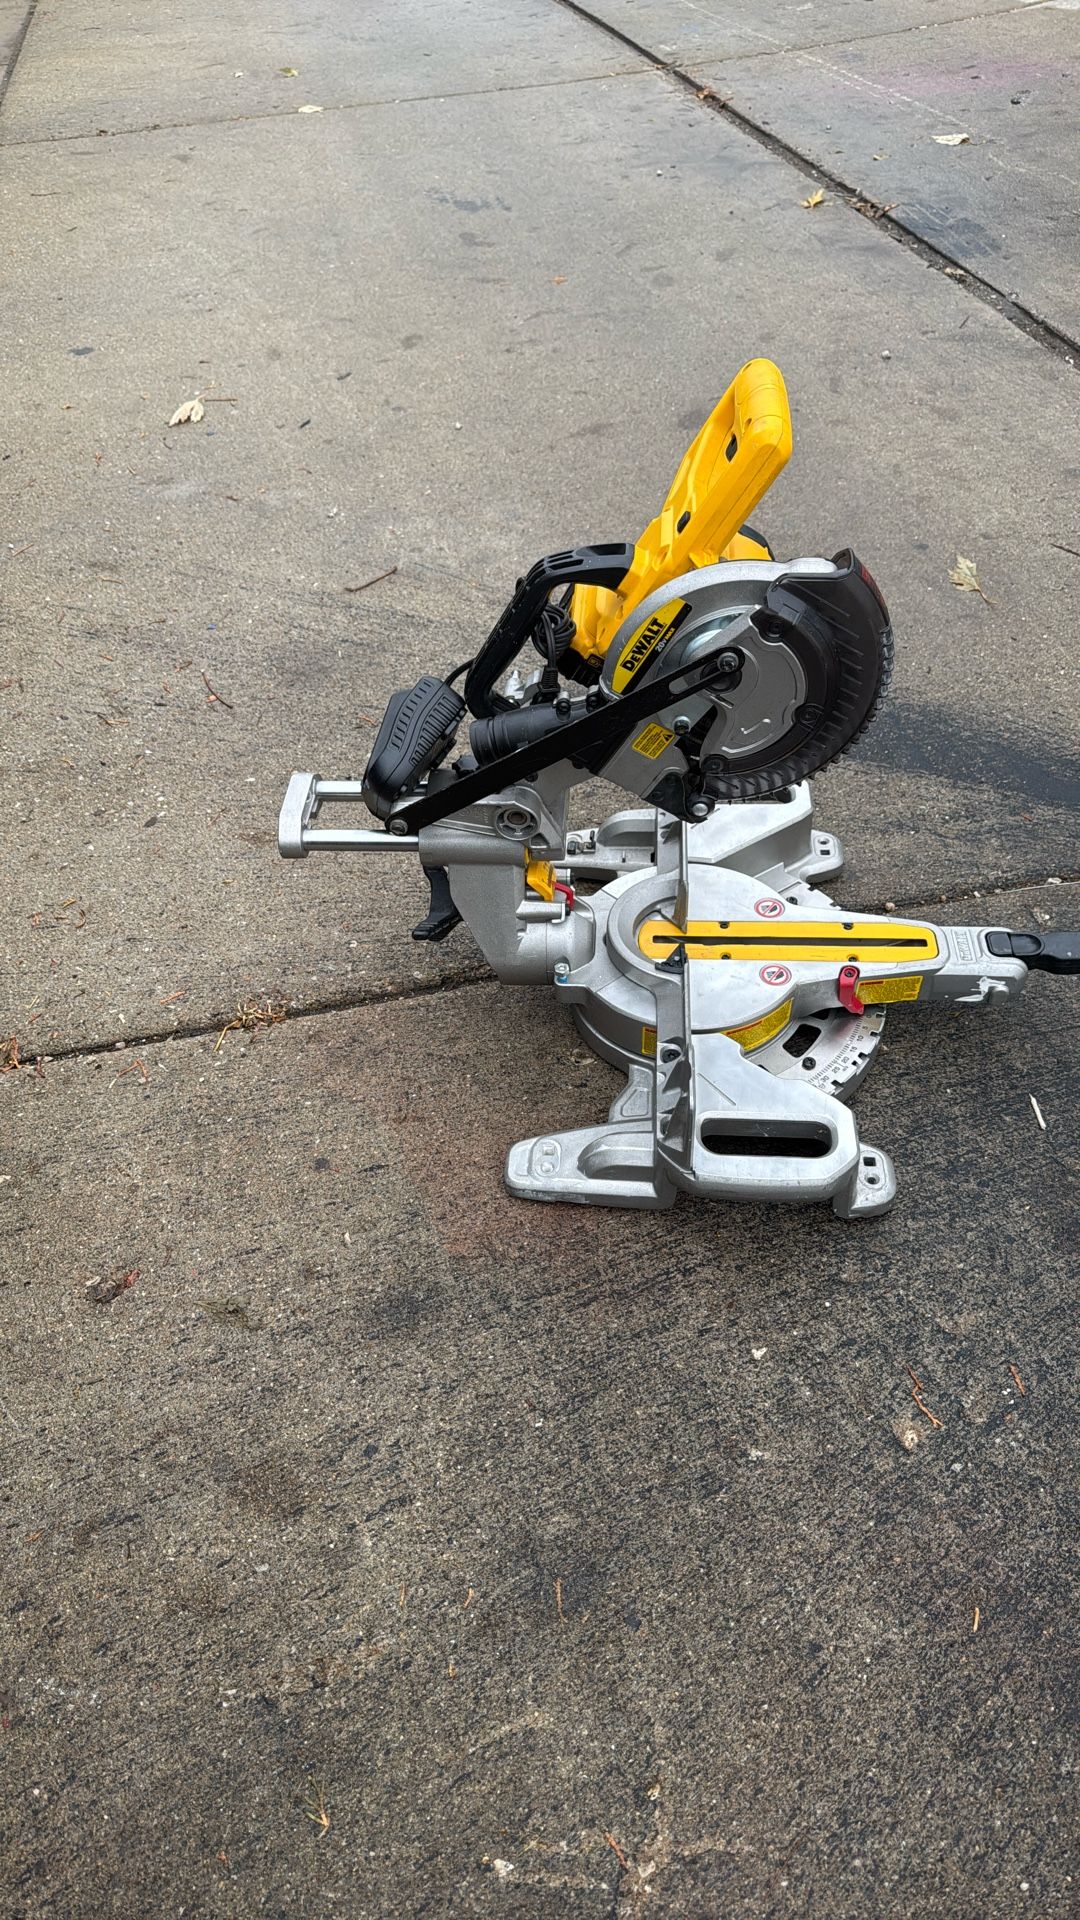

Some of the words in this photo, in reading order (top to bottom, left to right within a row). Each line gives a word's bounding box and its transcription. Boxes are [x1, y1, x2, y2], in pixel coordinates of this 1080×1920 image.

[665, 627, 676, 640] MAX
[622, 618, 665, 672] DEWALT
[856, 1034, 864, 1042] 10
[841, 1056, 850, 1064] 20
[831, 1066, 841, 1074] 25
